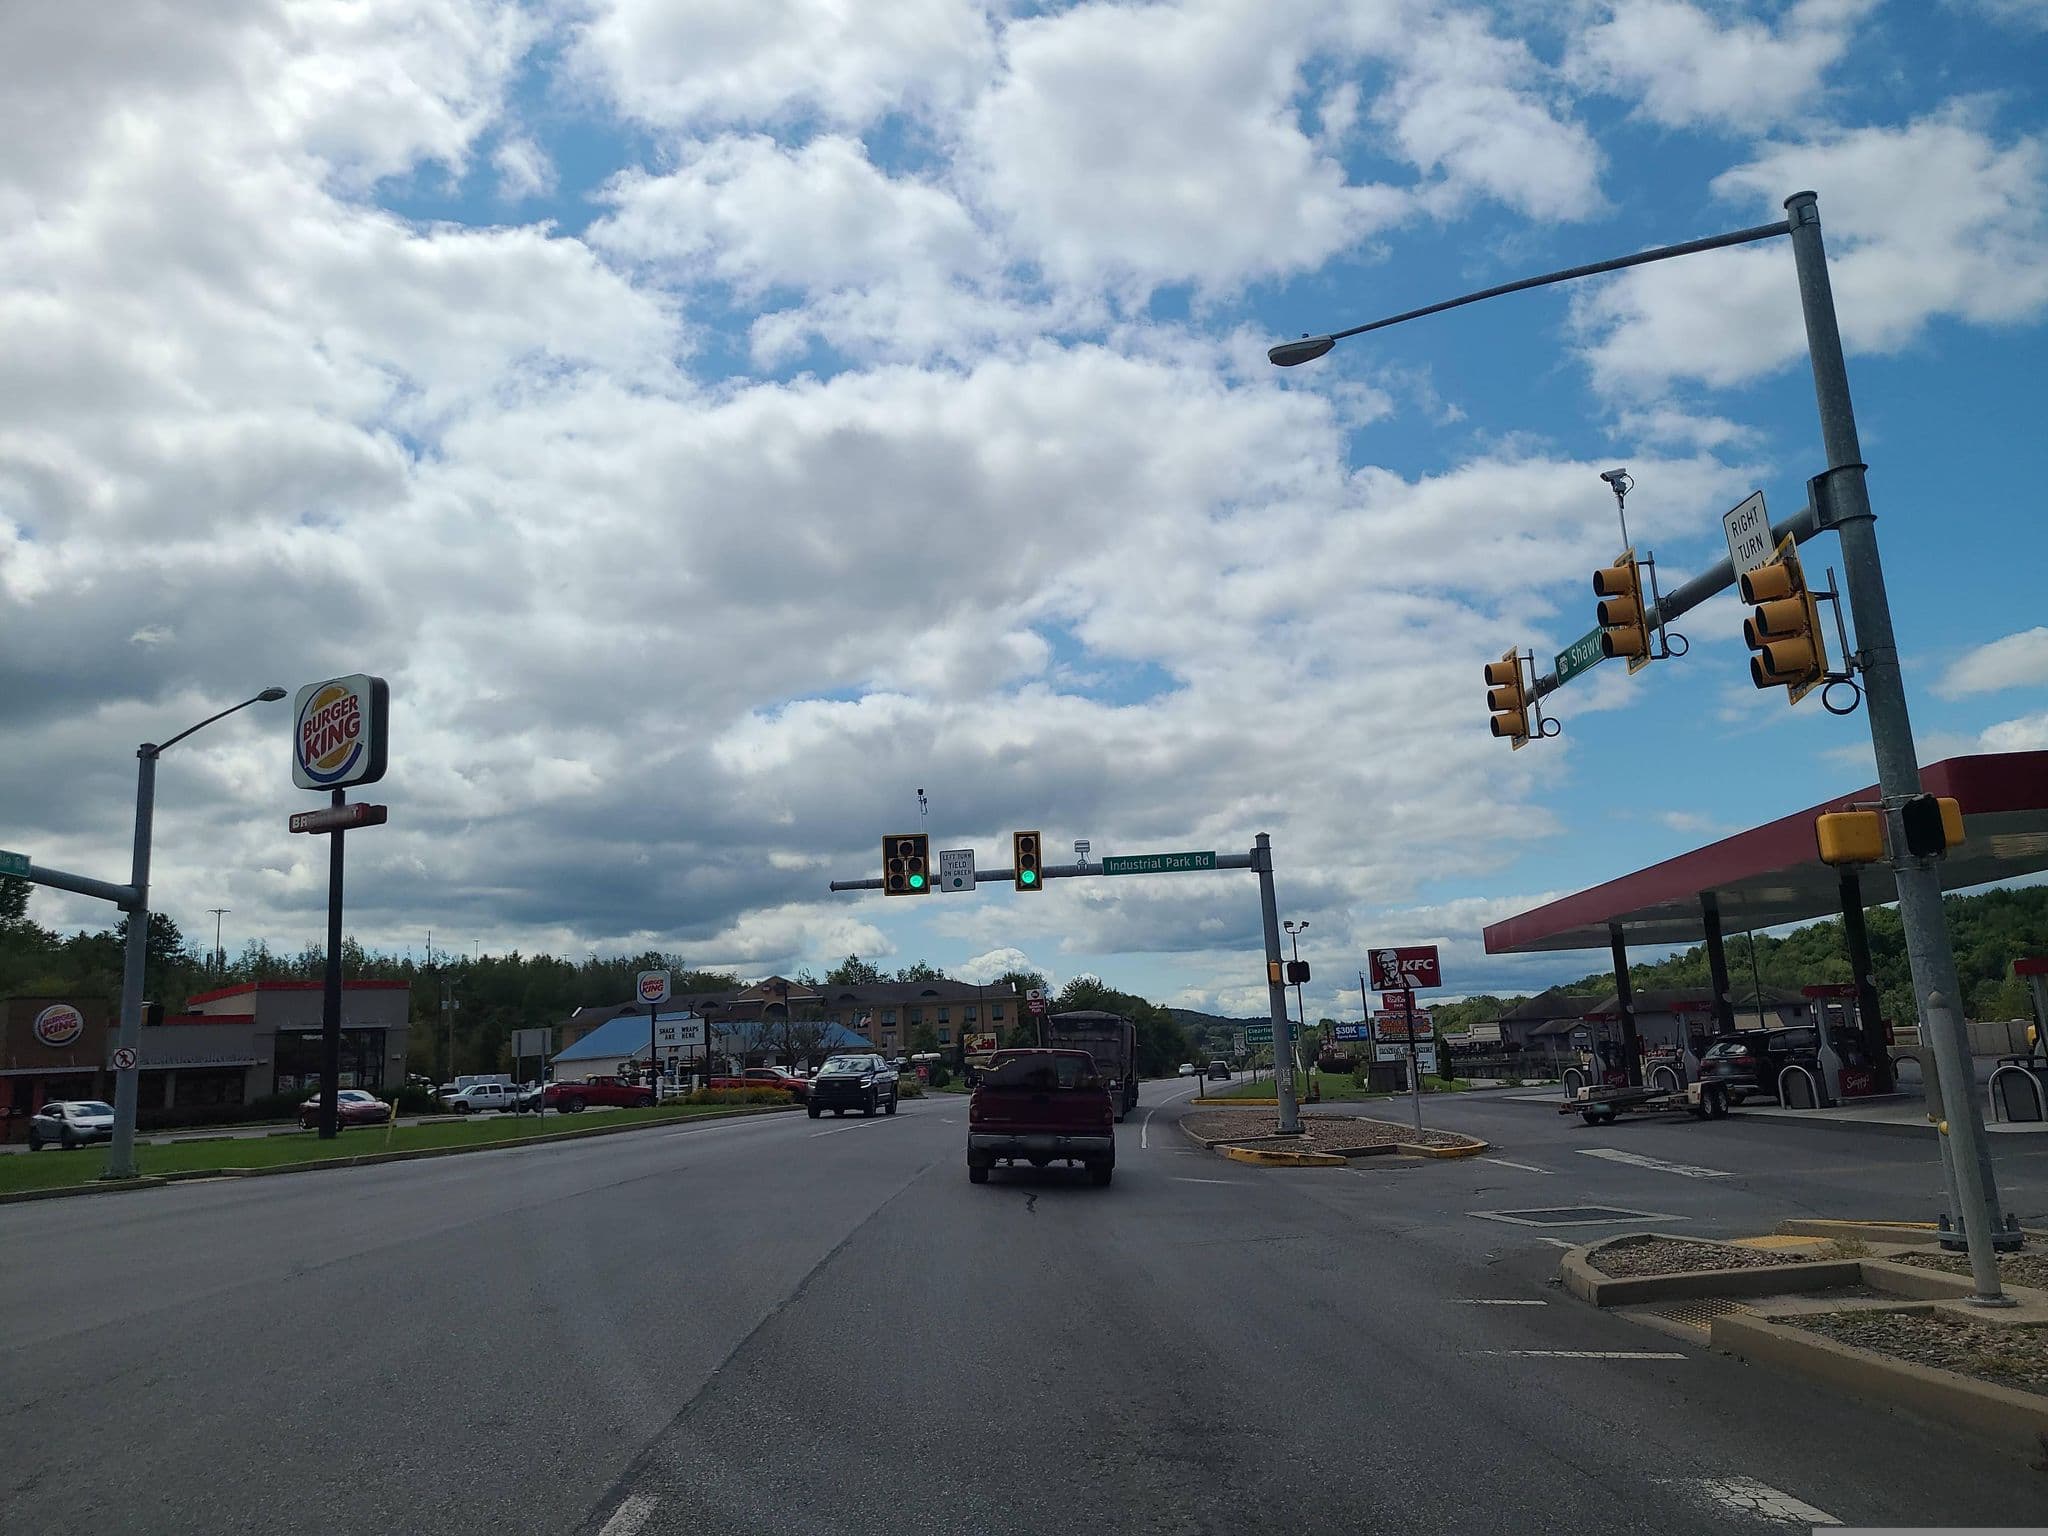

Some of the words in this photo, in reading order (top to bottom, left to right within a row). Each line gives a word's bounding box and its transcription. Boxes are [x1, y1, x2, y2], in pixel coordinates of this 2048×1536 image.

[1731, 506, 1759, 538] RIGHT
[1738, 533, 1764, 562] TURN
[1571, 628, 1613, 668] Shawvi
[303, 694, 359, 741] BURGER
[304, 711, 361, 768] KING
[942, 853, 956, 861] LEFT
[1110, 857, 1162, 872] Industrial
[1166, 857, 1191, 868] Park
[1195, 855, 1210, 867] Rd
[947, 860, 967, 870] YIELD
[943, 869, 952, 877] ON
[953, 868, 972, 876] GREEN
[1400, 958, 1434, 972] KFC
[643, 979, 665, 987] BURGER
[643, 984, 665, 994] KING
[43, 1012, 76, 1026] BURGER
[44, 1019, 78, 1037] KING
[681, 1025, 699, 1033] WRAPS
[1335, 1025, 1357, 1035] $30K
